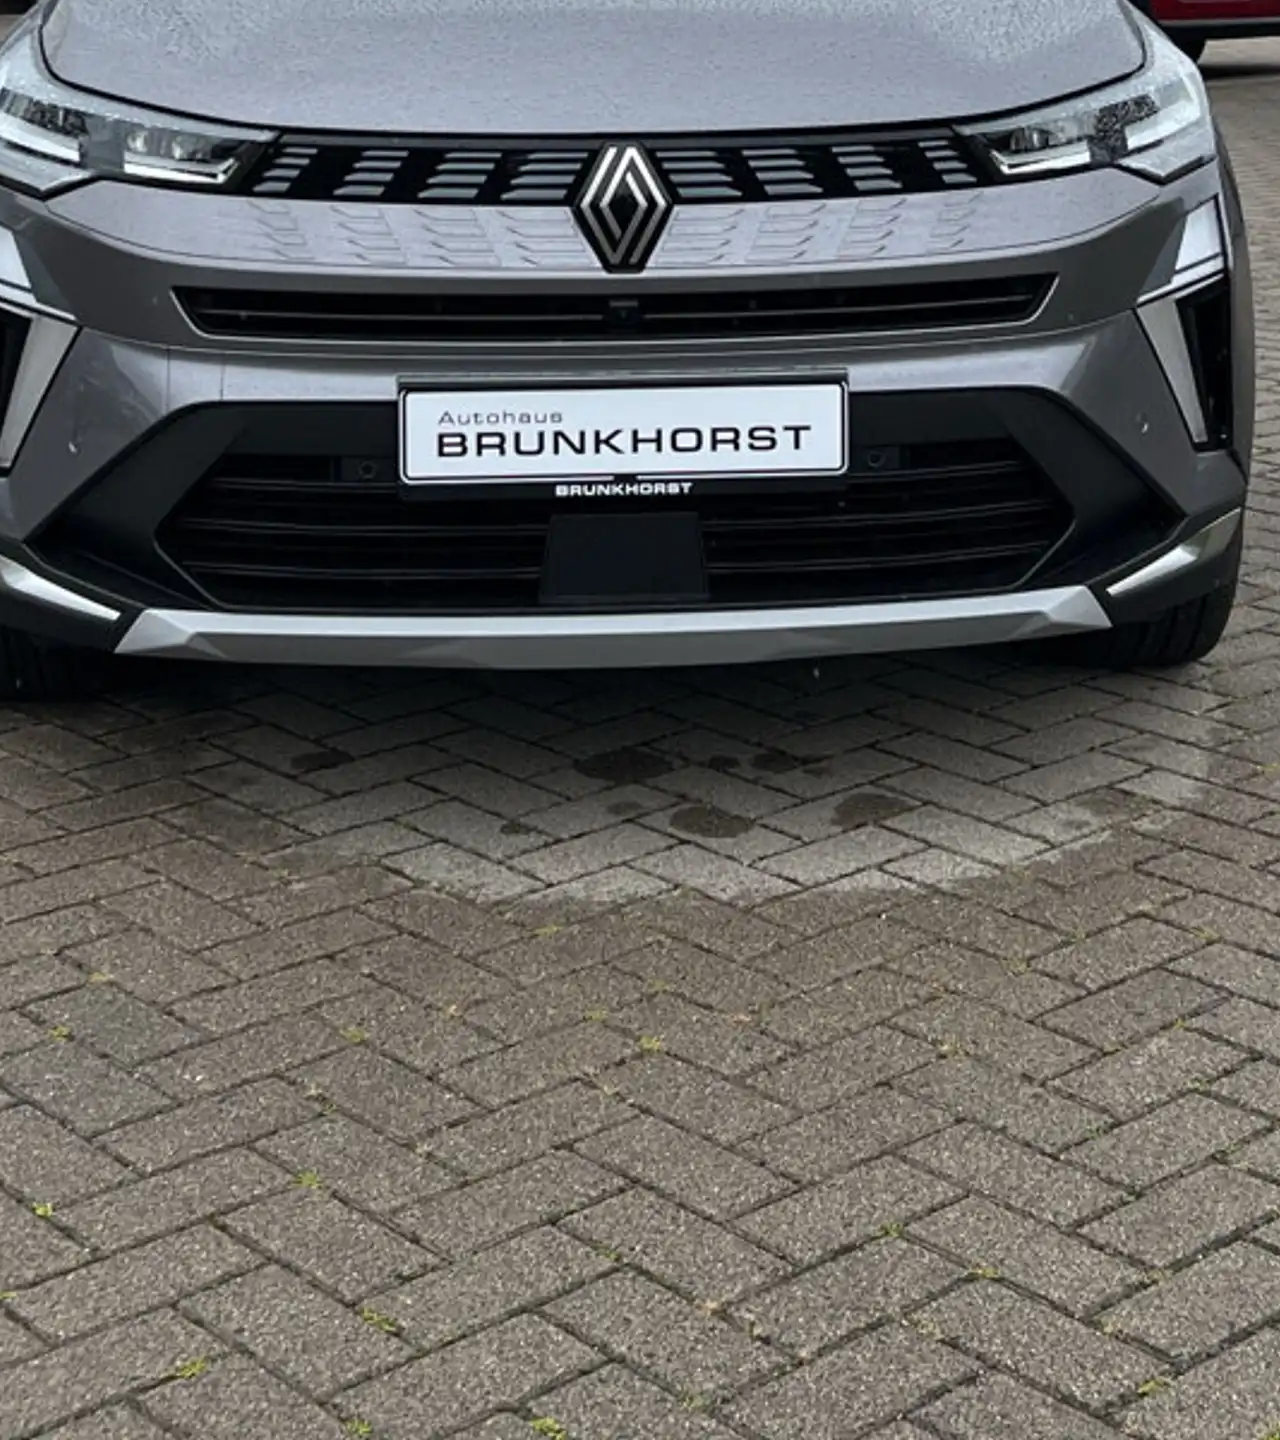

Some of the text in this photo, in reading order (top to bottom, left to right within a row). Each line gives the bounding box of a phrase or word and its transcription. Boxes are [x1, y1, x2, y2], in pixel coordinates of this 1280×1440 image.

[437, 410, 564, 426] Autohaus
[437, 425, 812, 458] BRUNKHORST
[555, 481, 694, 497] BRUNKHORST
